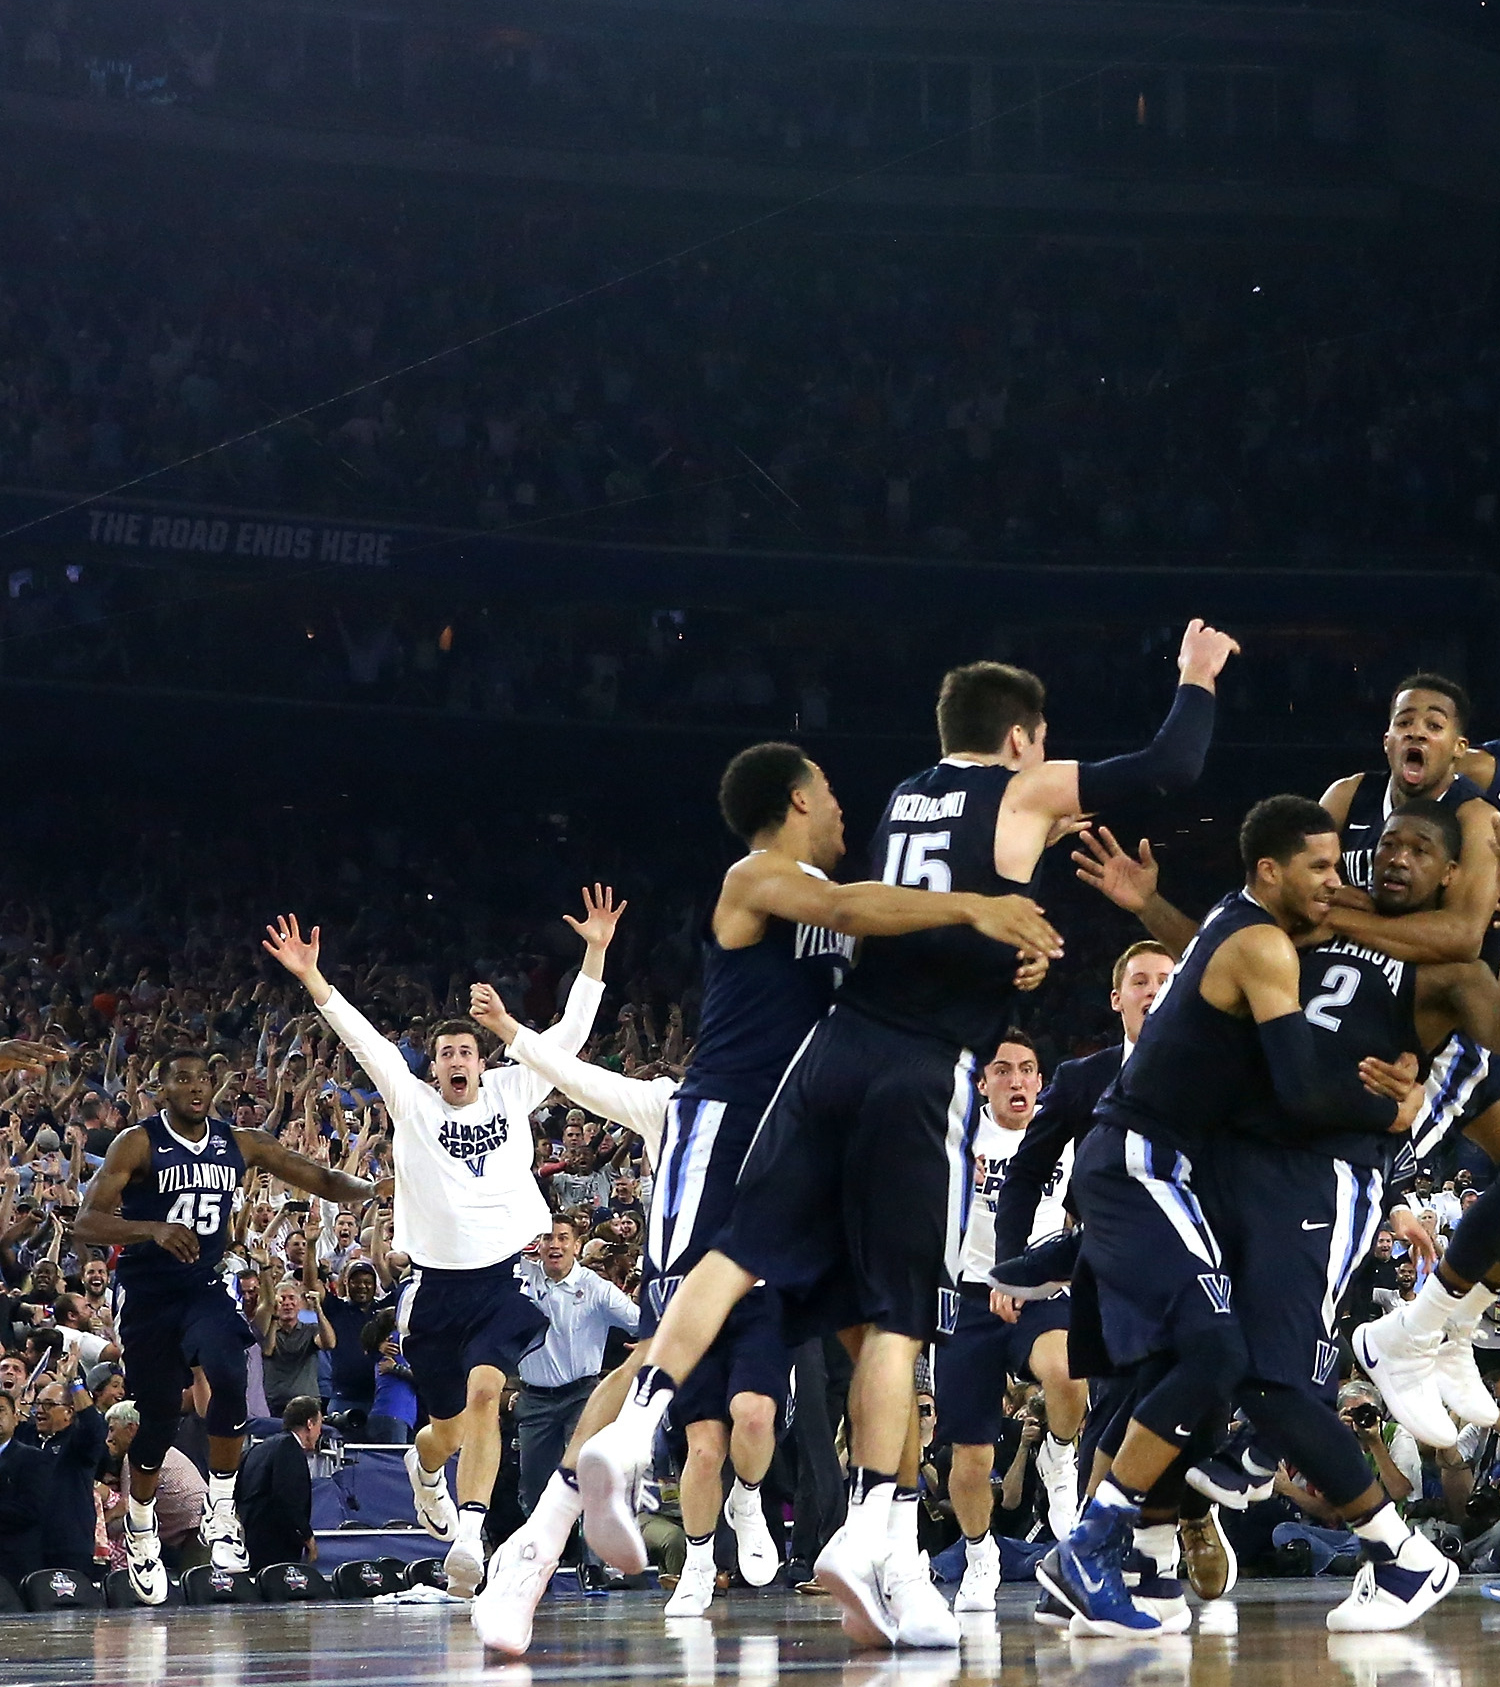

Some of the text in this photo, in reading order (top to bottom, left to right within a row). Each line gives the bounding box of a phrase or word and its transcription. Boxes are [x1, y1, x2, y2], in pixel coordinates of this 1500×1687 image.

[89, 509, 393, 567] THE ROAD ENDS HERE
[882, 831, 952, 893] 15
[1303, 964, 1363, 1033] 2
[158, 1163, 238, 1194] VILLANOVA
[166, 1193, 223, 1235] 45
